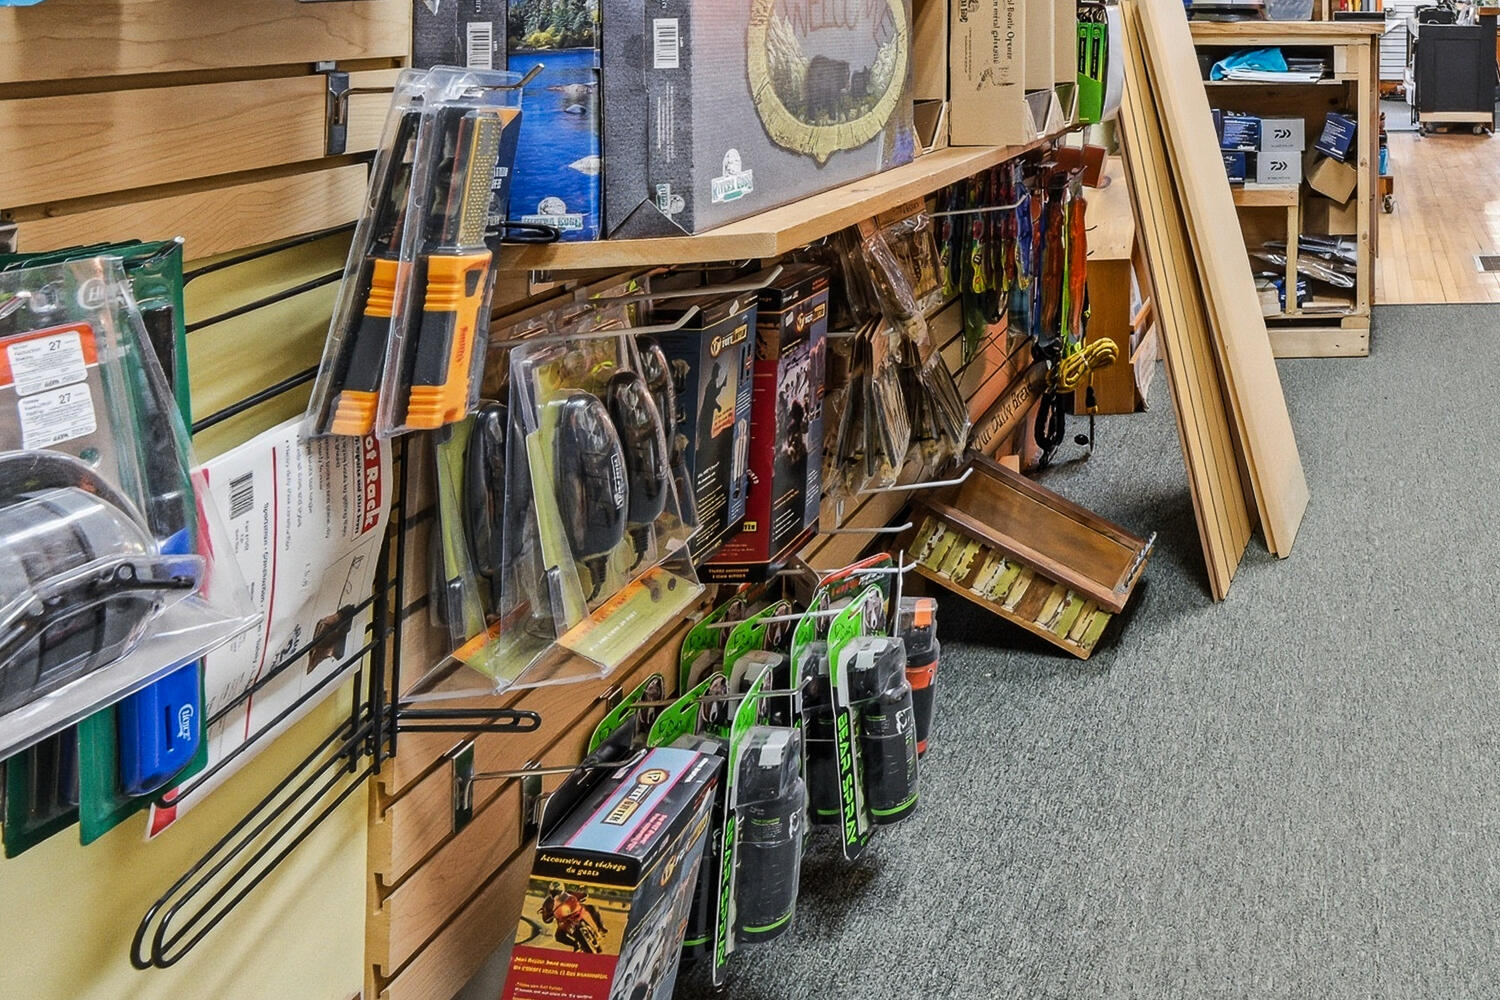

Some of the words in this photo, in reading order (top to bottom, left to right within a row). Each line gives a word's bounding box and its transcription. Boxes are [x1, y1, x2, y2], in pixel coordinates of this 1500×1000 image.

[49, 340, 62, 351] 27
[58, 393, 72, 404] 27
[364, 469, 381, 528] Rack
